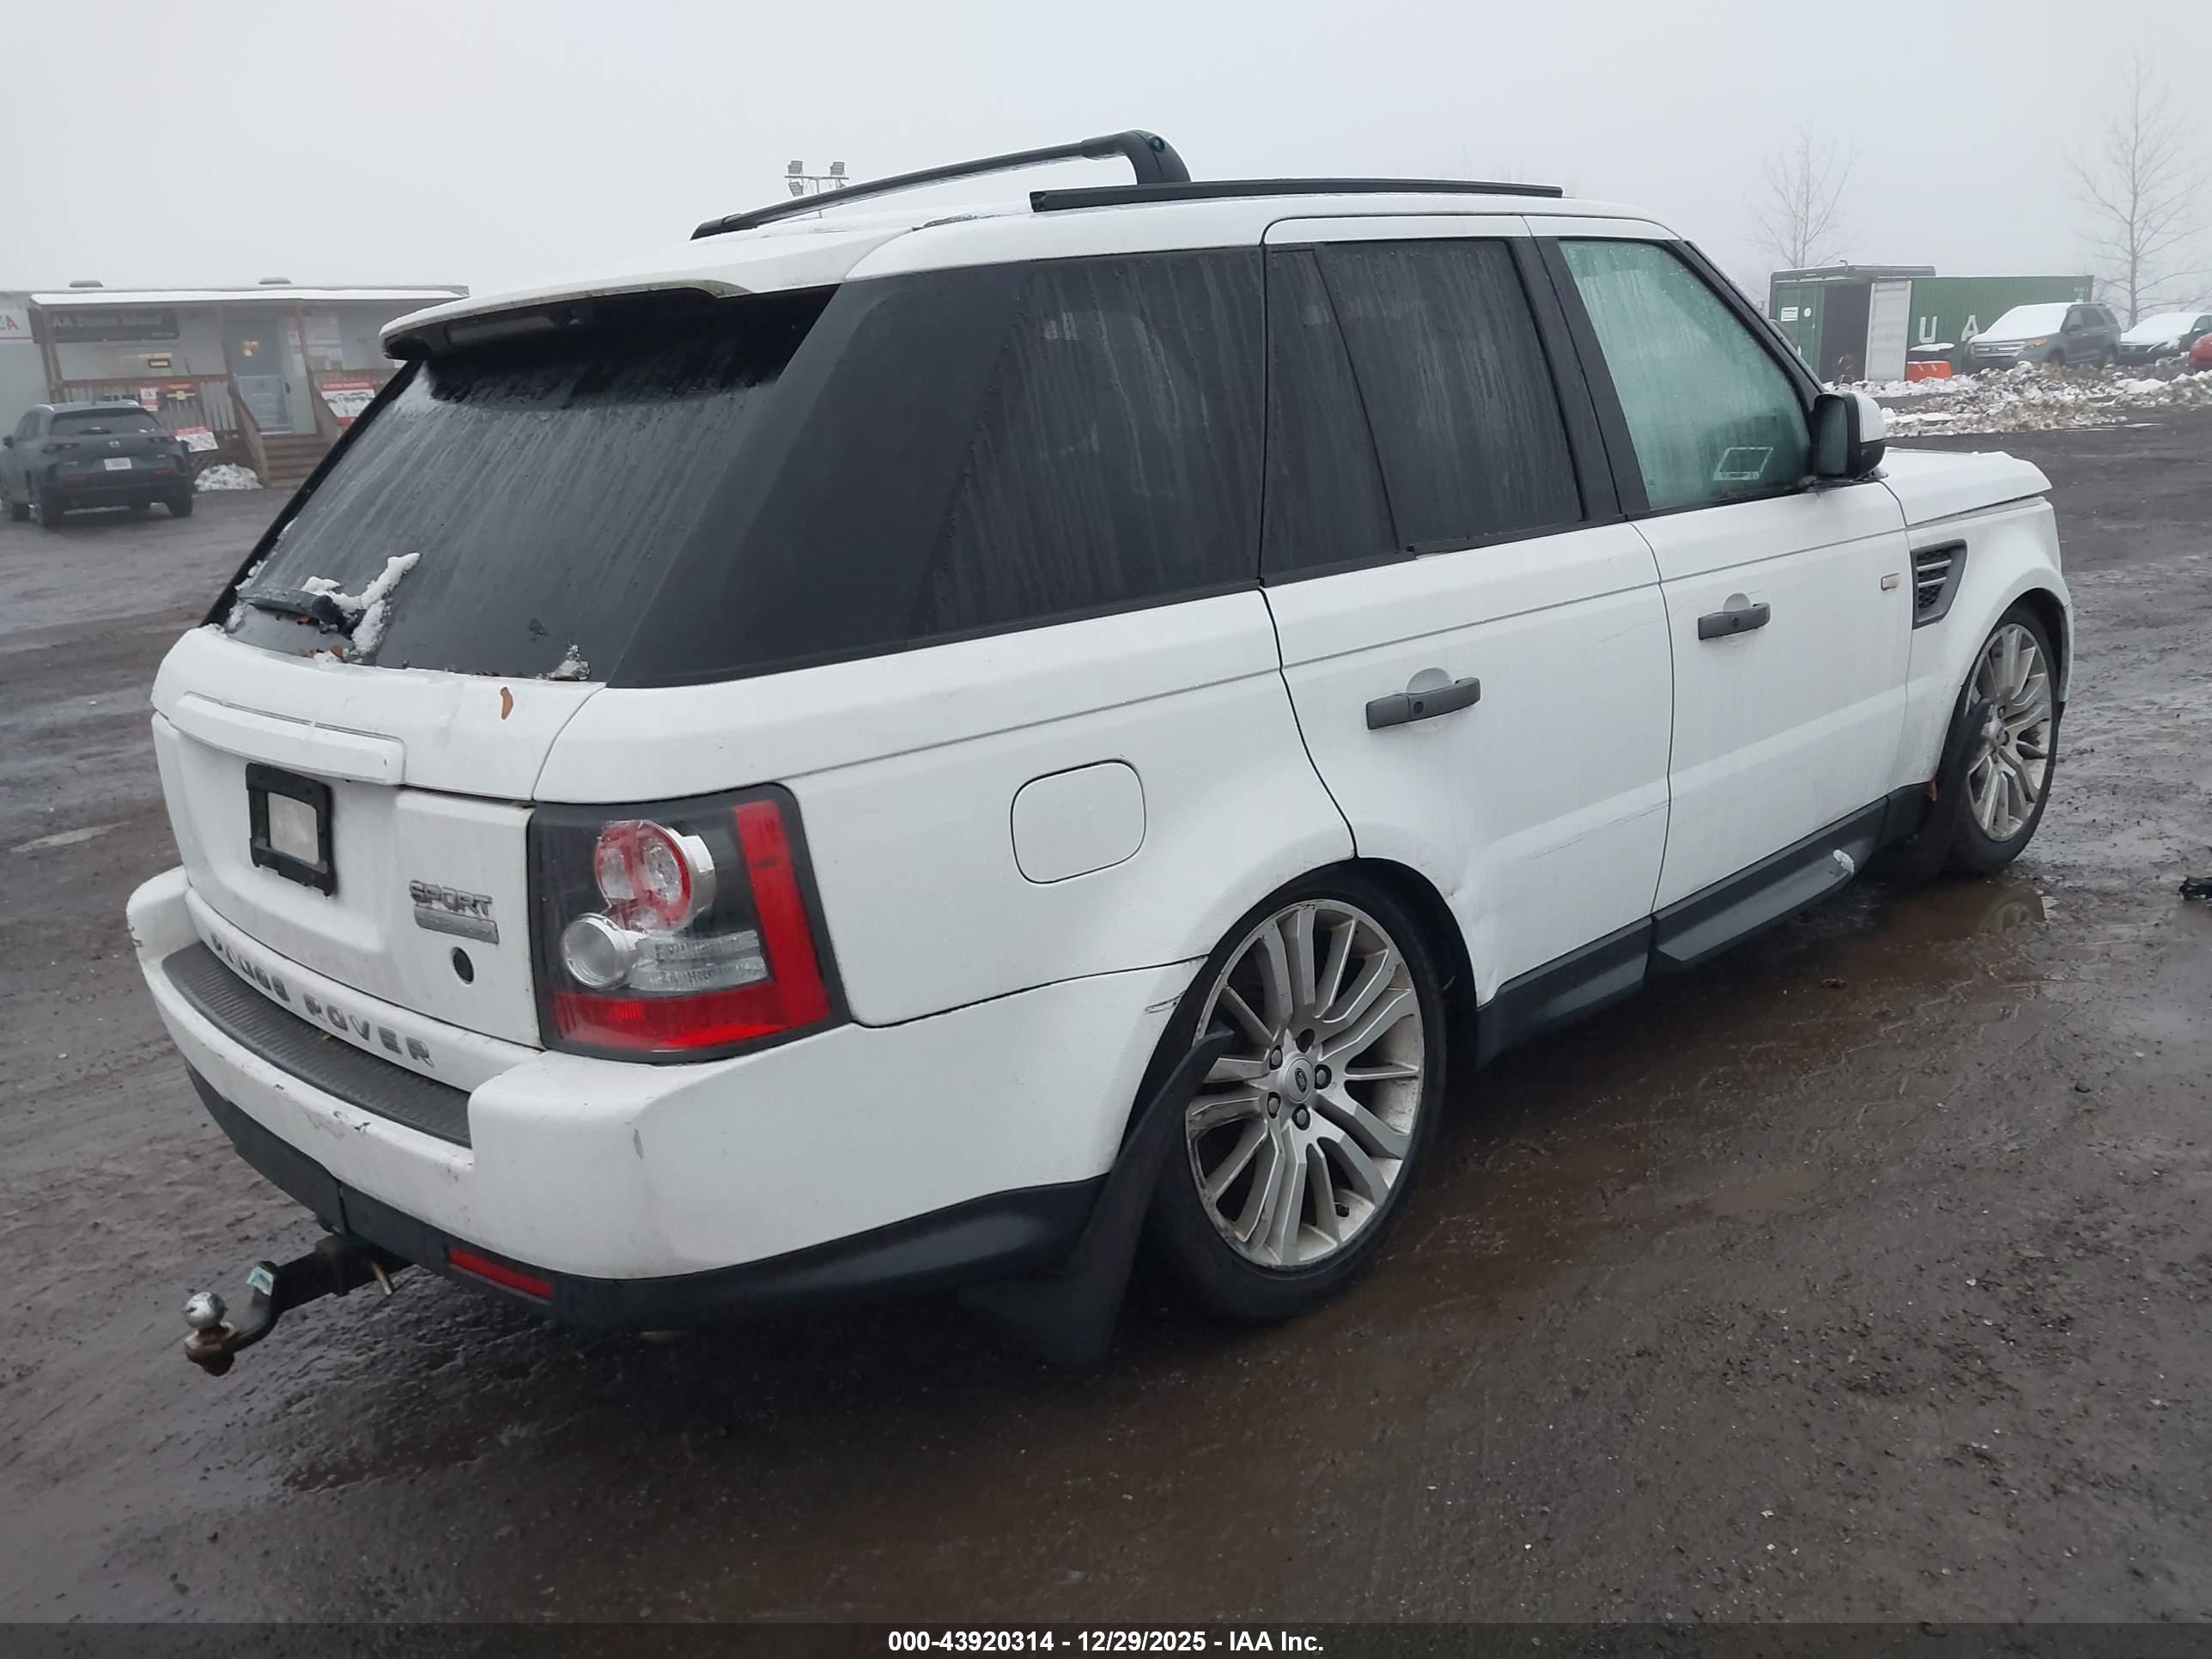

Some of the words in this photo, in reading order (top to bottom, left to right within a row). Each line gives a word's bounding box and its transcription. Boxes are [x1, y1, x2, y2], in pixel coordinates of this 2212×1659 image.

[1918, 316, 1938, 343] U
[409, 879, 493, 916] SPORT
[302, 994, 434, 1067] ROVER
